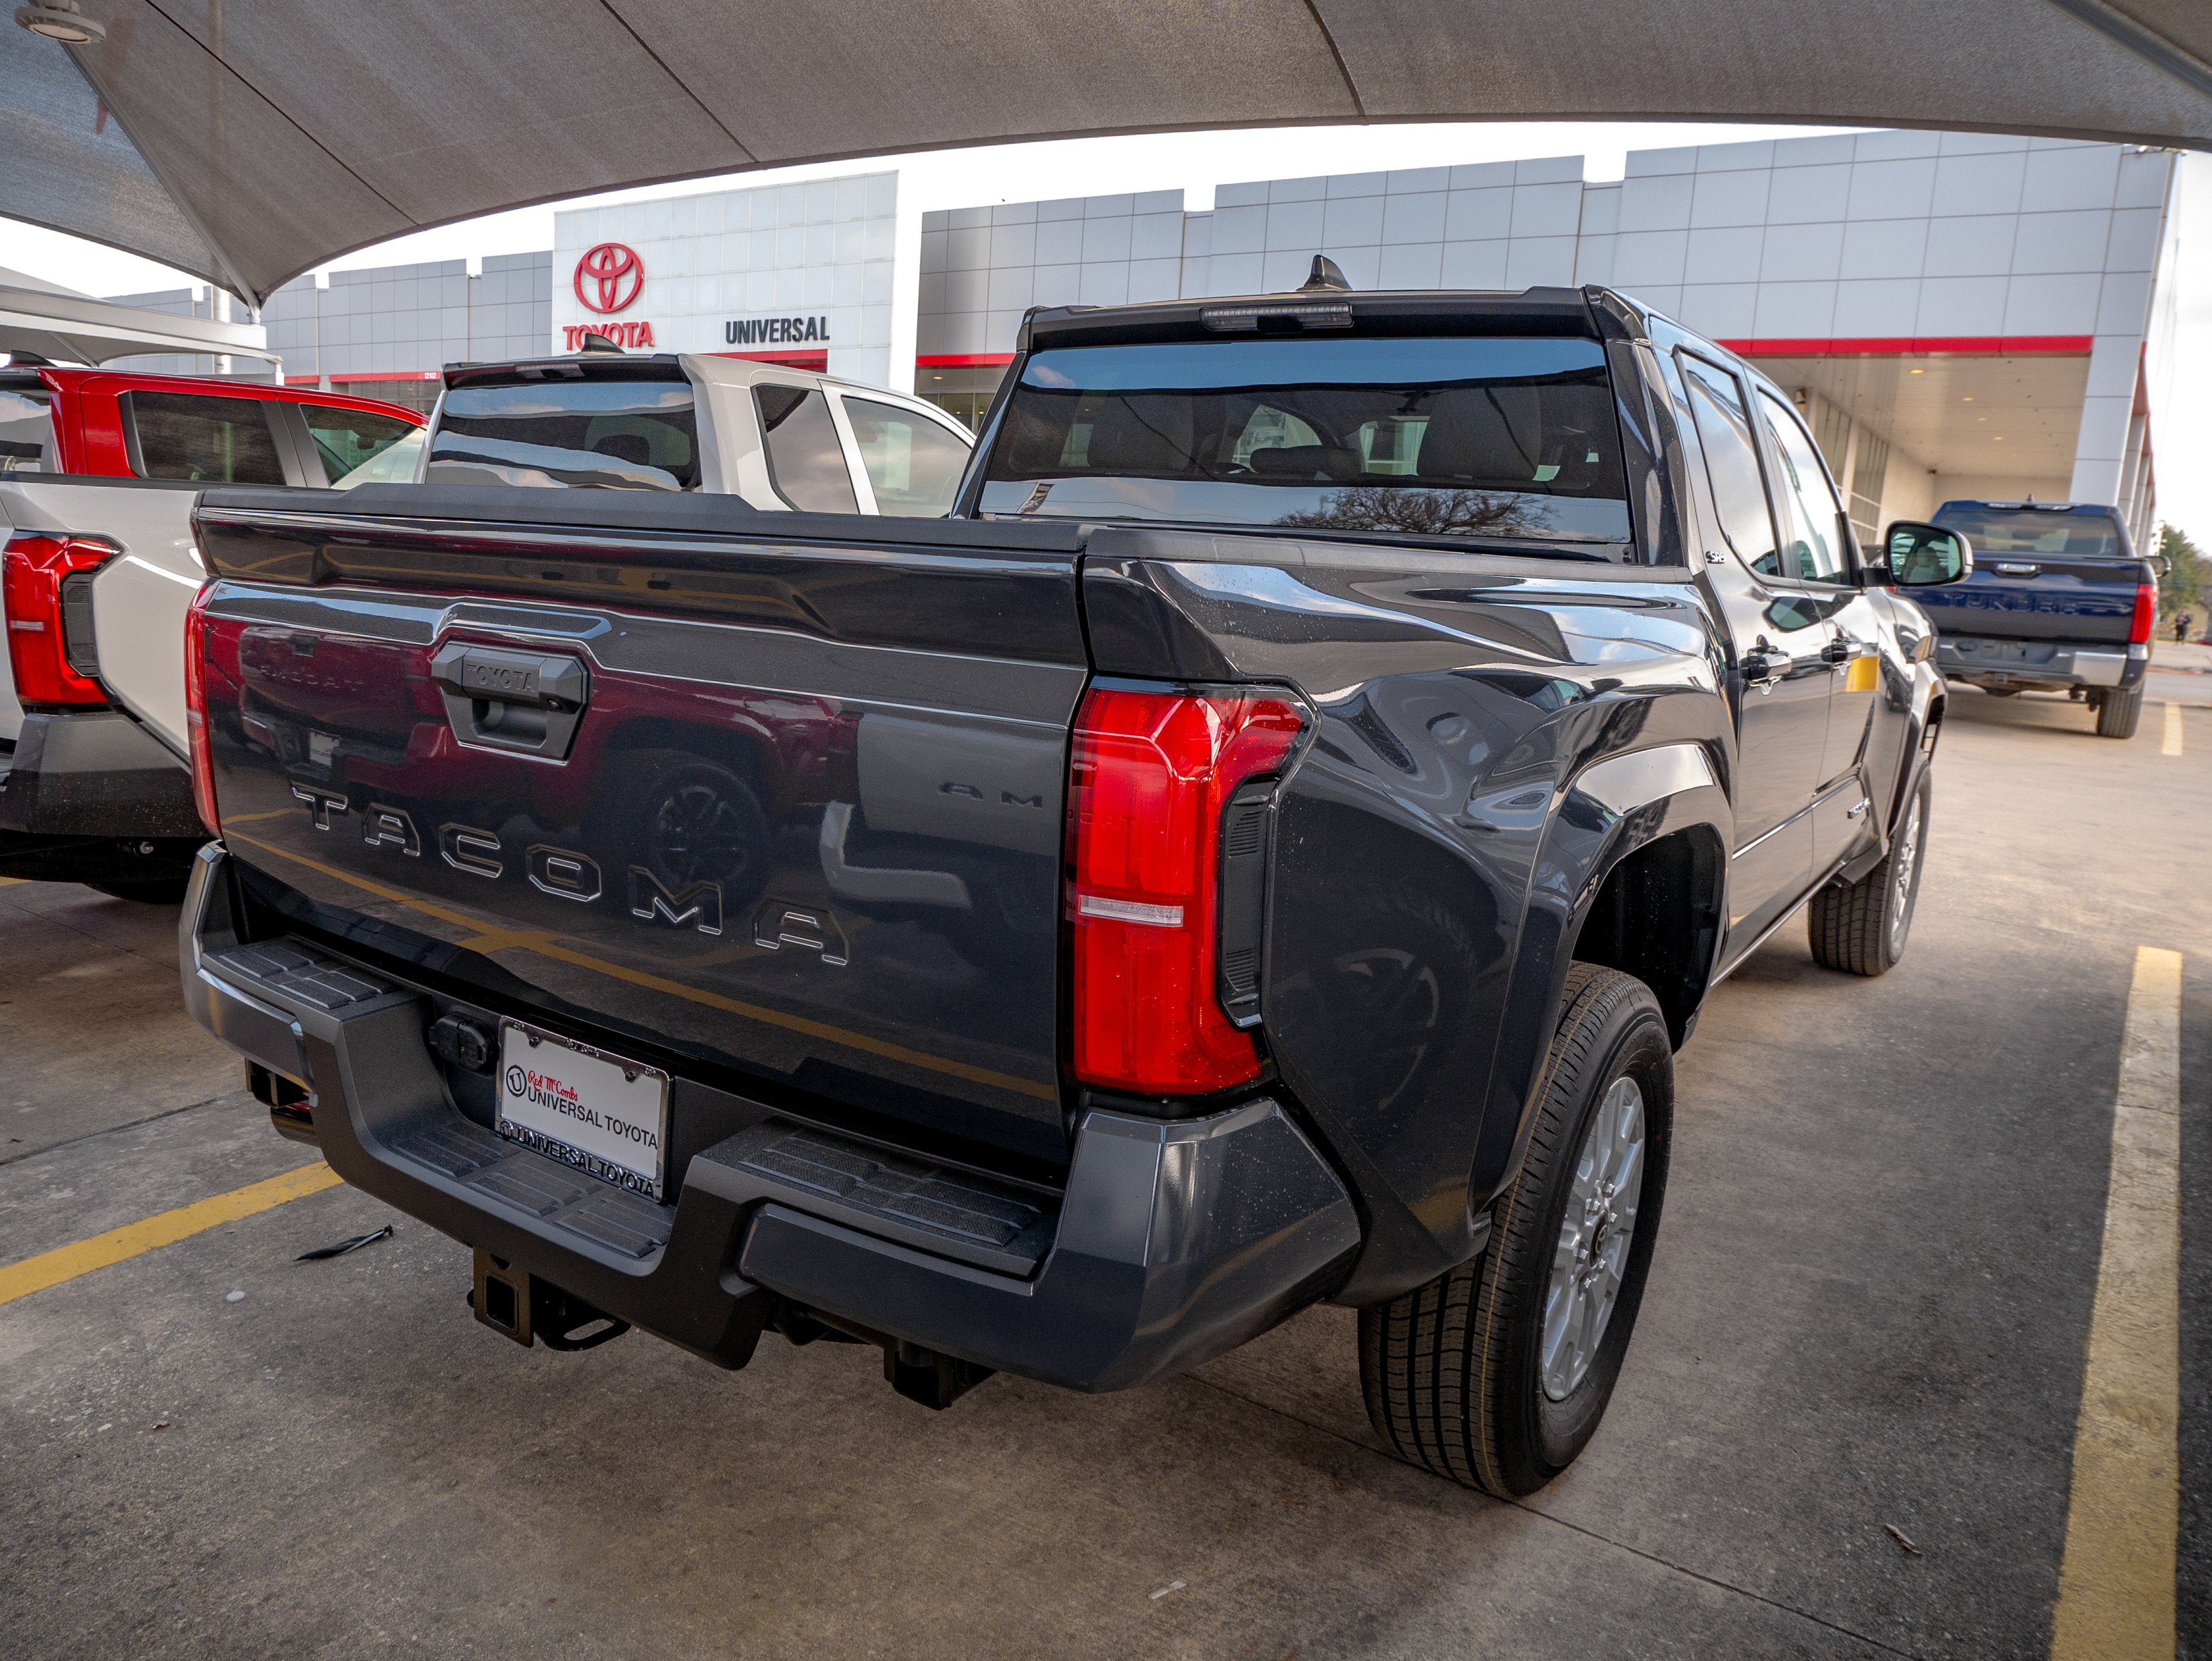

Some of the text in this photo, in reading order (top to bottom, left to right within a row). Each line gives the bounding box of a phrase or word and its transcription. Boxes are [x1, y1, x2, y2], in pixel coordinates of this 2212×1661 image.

[726, 316, 830, 344] UNIVERSAL
[467, 664, 536, 693] TOYOTA
[290, 781, 851, 966] TACOMA
[528, 1070, 578, 1102] Red McCombs
[528, 1086, 658, 1151] UNIVERSAL TOYOTA
[517, 1126, 655, 1199] UNIVERSAL TOYOTA
